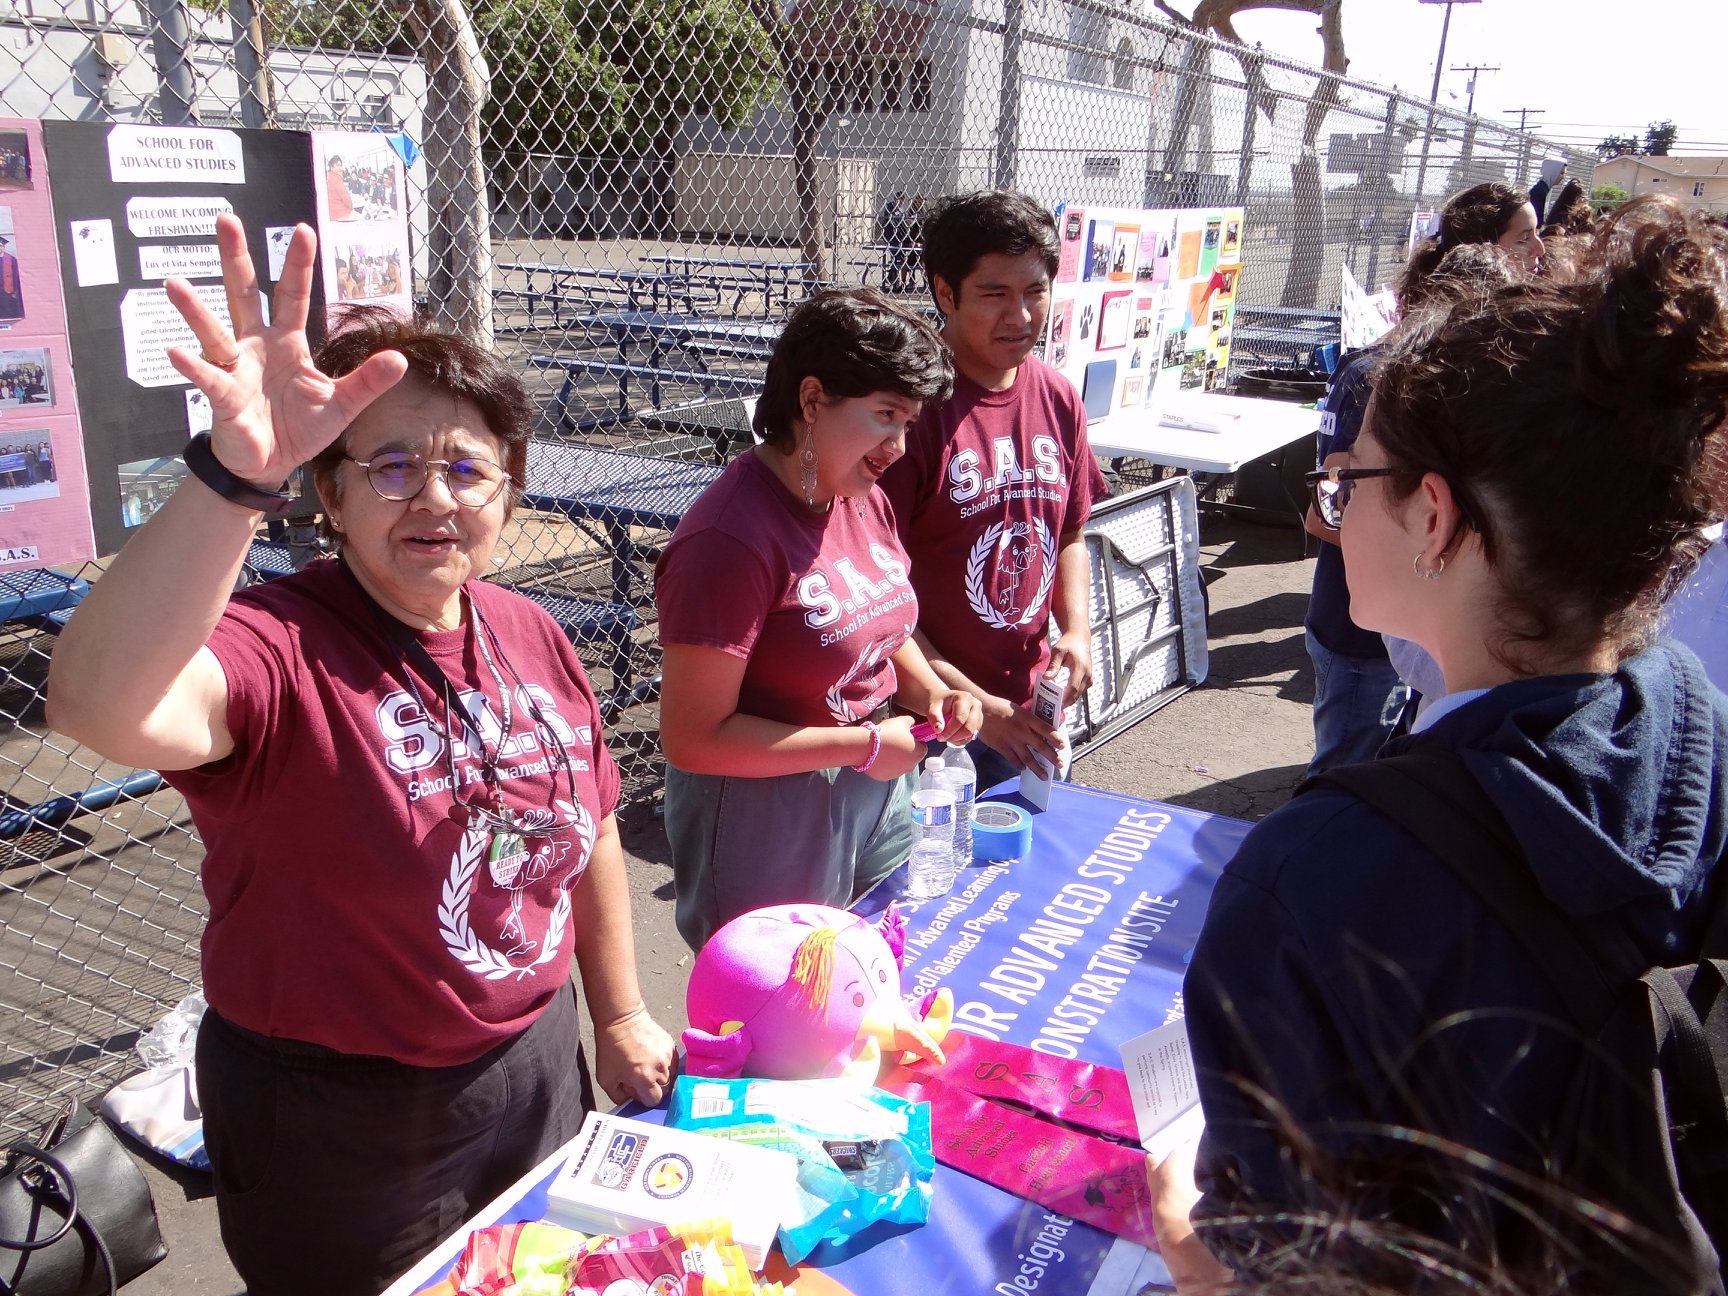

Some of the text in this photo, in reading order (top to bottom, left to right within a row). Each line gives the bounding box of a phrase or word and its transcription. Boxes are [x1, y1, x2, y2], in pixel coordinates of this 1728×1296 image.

[120, 156, 236, 171] ADVANCED STUDIES
[137, 136, 214, 151] SCHOOL FOR
[130, 206, 232, 220] WELCOME INCOMING
[145, 257, 222, 270] Lux et Vita Sempite
[162, 245, 213, 254] OUR MOTTO:
[949, 435, 1067, 504] S.A.S.
[960, 497, 989, 519] School
[0, 547, 35, 561] .A.S.
[820, 618, 858, 647] School
[856, 611, 870, 628] For
[869, 593, 903, 620] Advanced
[375, 683, 593, 775] S.A.S.
[979, 882, 1112, 1005] ADVANCED
[1078, 808, 1172, 886] STUDIES
[1031, 891, 1179, 1060] ONSTRATION SITE
[975, 1062, 1009, 1081] S
[1069, 1084, 1104, 1109] S
[620, 1138, 649, 1191] GARFIELD
[995, 1214, 1074, 1296] Designat
